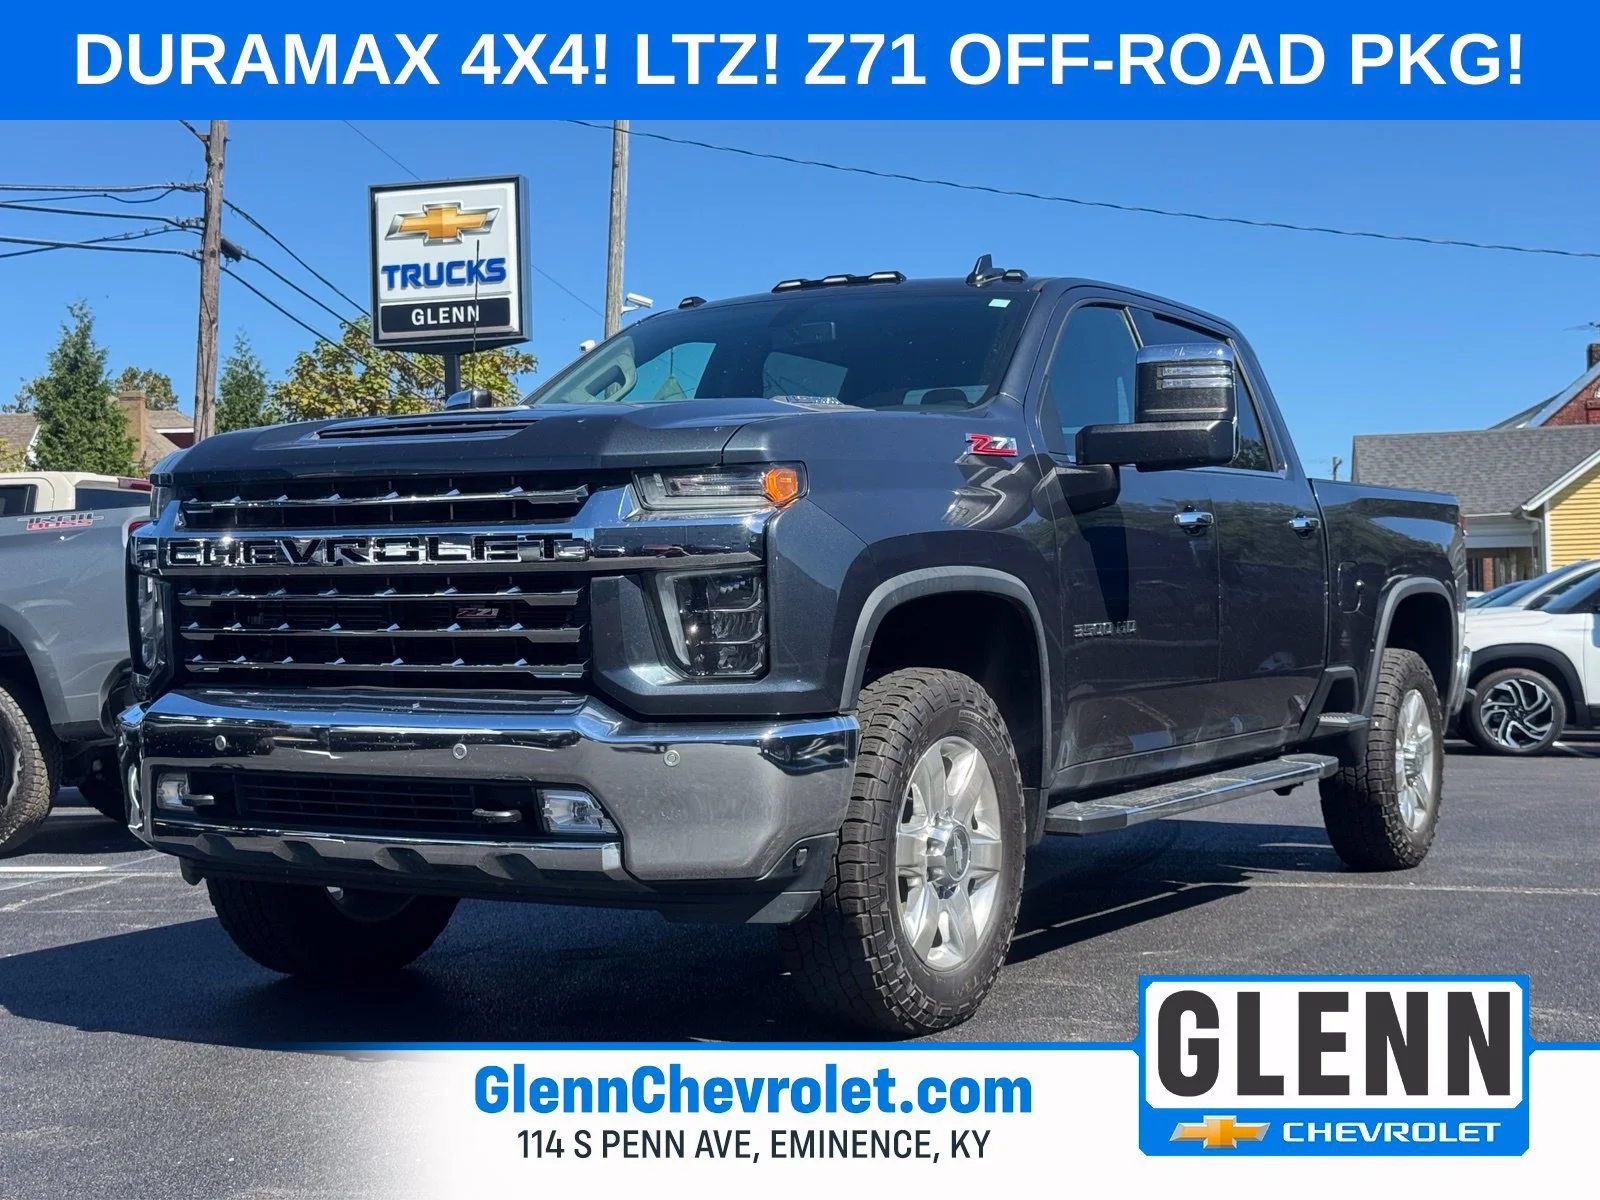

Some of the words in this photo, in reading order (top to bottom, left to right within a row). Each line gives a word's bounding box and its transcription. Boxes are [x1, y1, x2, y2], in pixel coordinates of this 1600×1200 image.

[382, 257, 506, 290] TRUCKS
[411, 305, 480, 326] GLENN
[965, 432, 1018, 456] Z71
[166, 532, 574, 567] CHEVROLET
